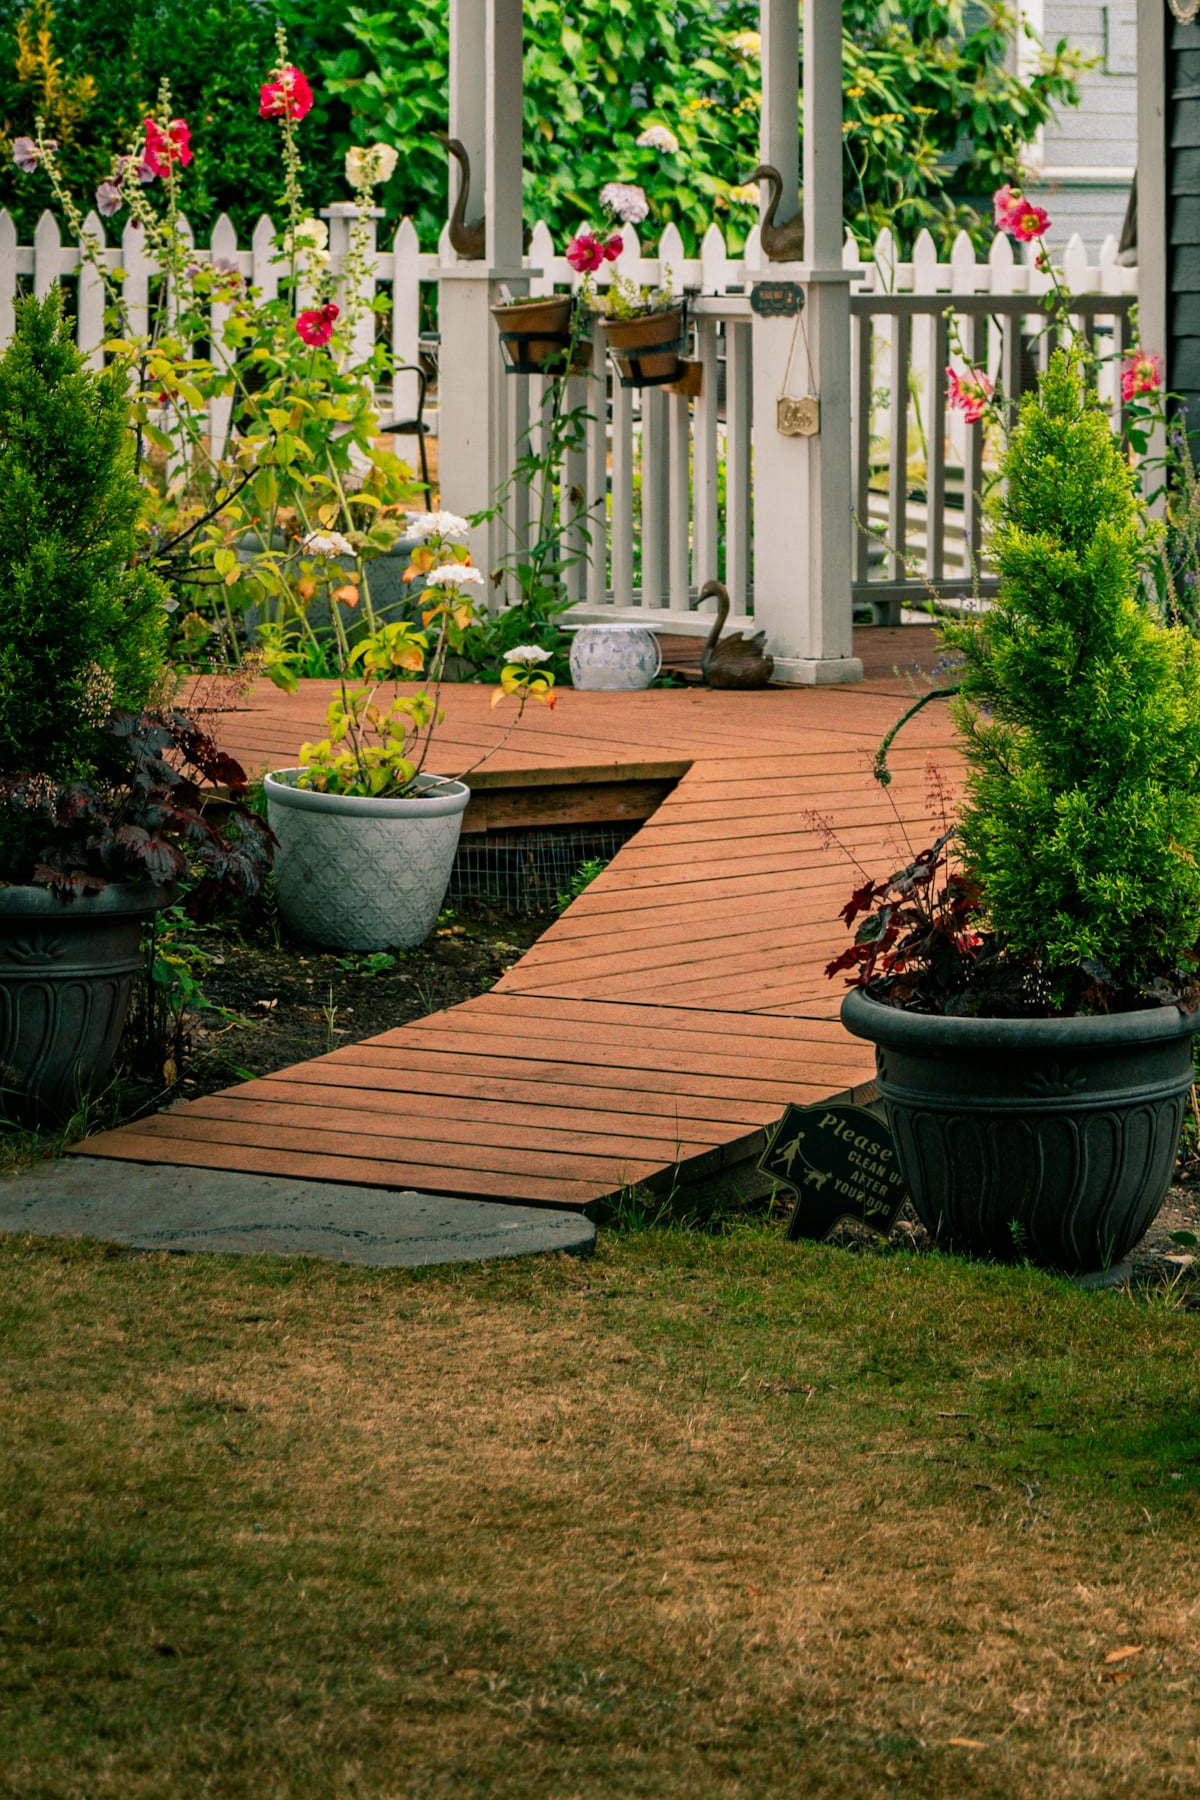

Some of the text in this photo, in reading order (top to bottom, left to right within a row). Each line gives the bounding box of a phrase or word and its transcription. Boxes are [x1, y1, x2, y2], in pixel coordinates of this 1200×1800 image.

[816, 1113, 893, 1161] Please
[848, 1150, 887, 1177] CLEAN
[834, 1178, 890, 1215] YOUR DOG
[850, 1171, 888, 1196] AFTER
